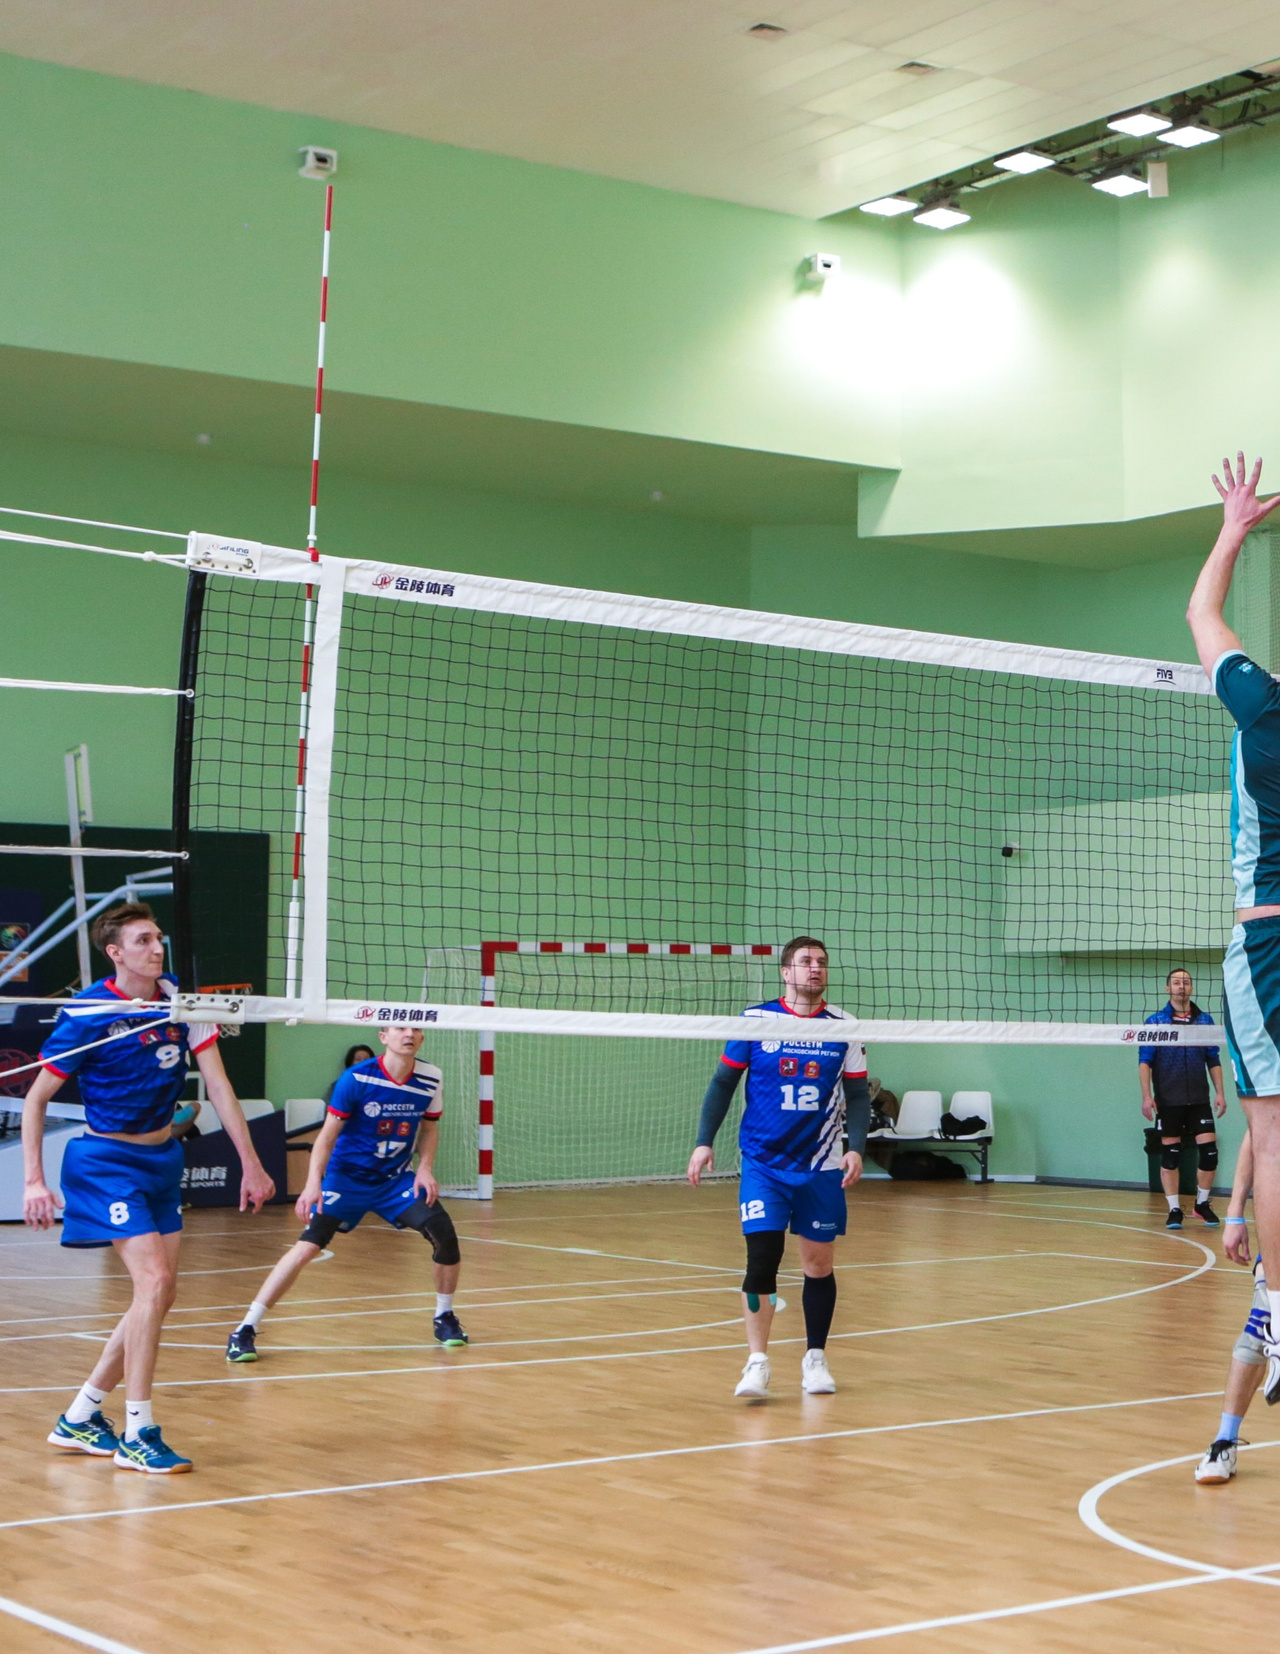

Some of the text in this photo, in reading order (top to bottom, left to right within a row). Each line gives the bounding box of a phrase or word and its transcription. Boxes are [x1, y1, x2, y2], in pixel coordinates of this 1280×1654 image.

[395, 577, 455, 597] 金陵体育
[378, 1008, 438, 1022] 金陵体育
[780, 1084, 820, 1111] 12
[373, 1141, 407, 1159] 17
[321, 1190, 341, 1205] 7
[109, 1201, 130, 1225] 8
[740, 1199, 765, 1222] 12
